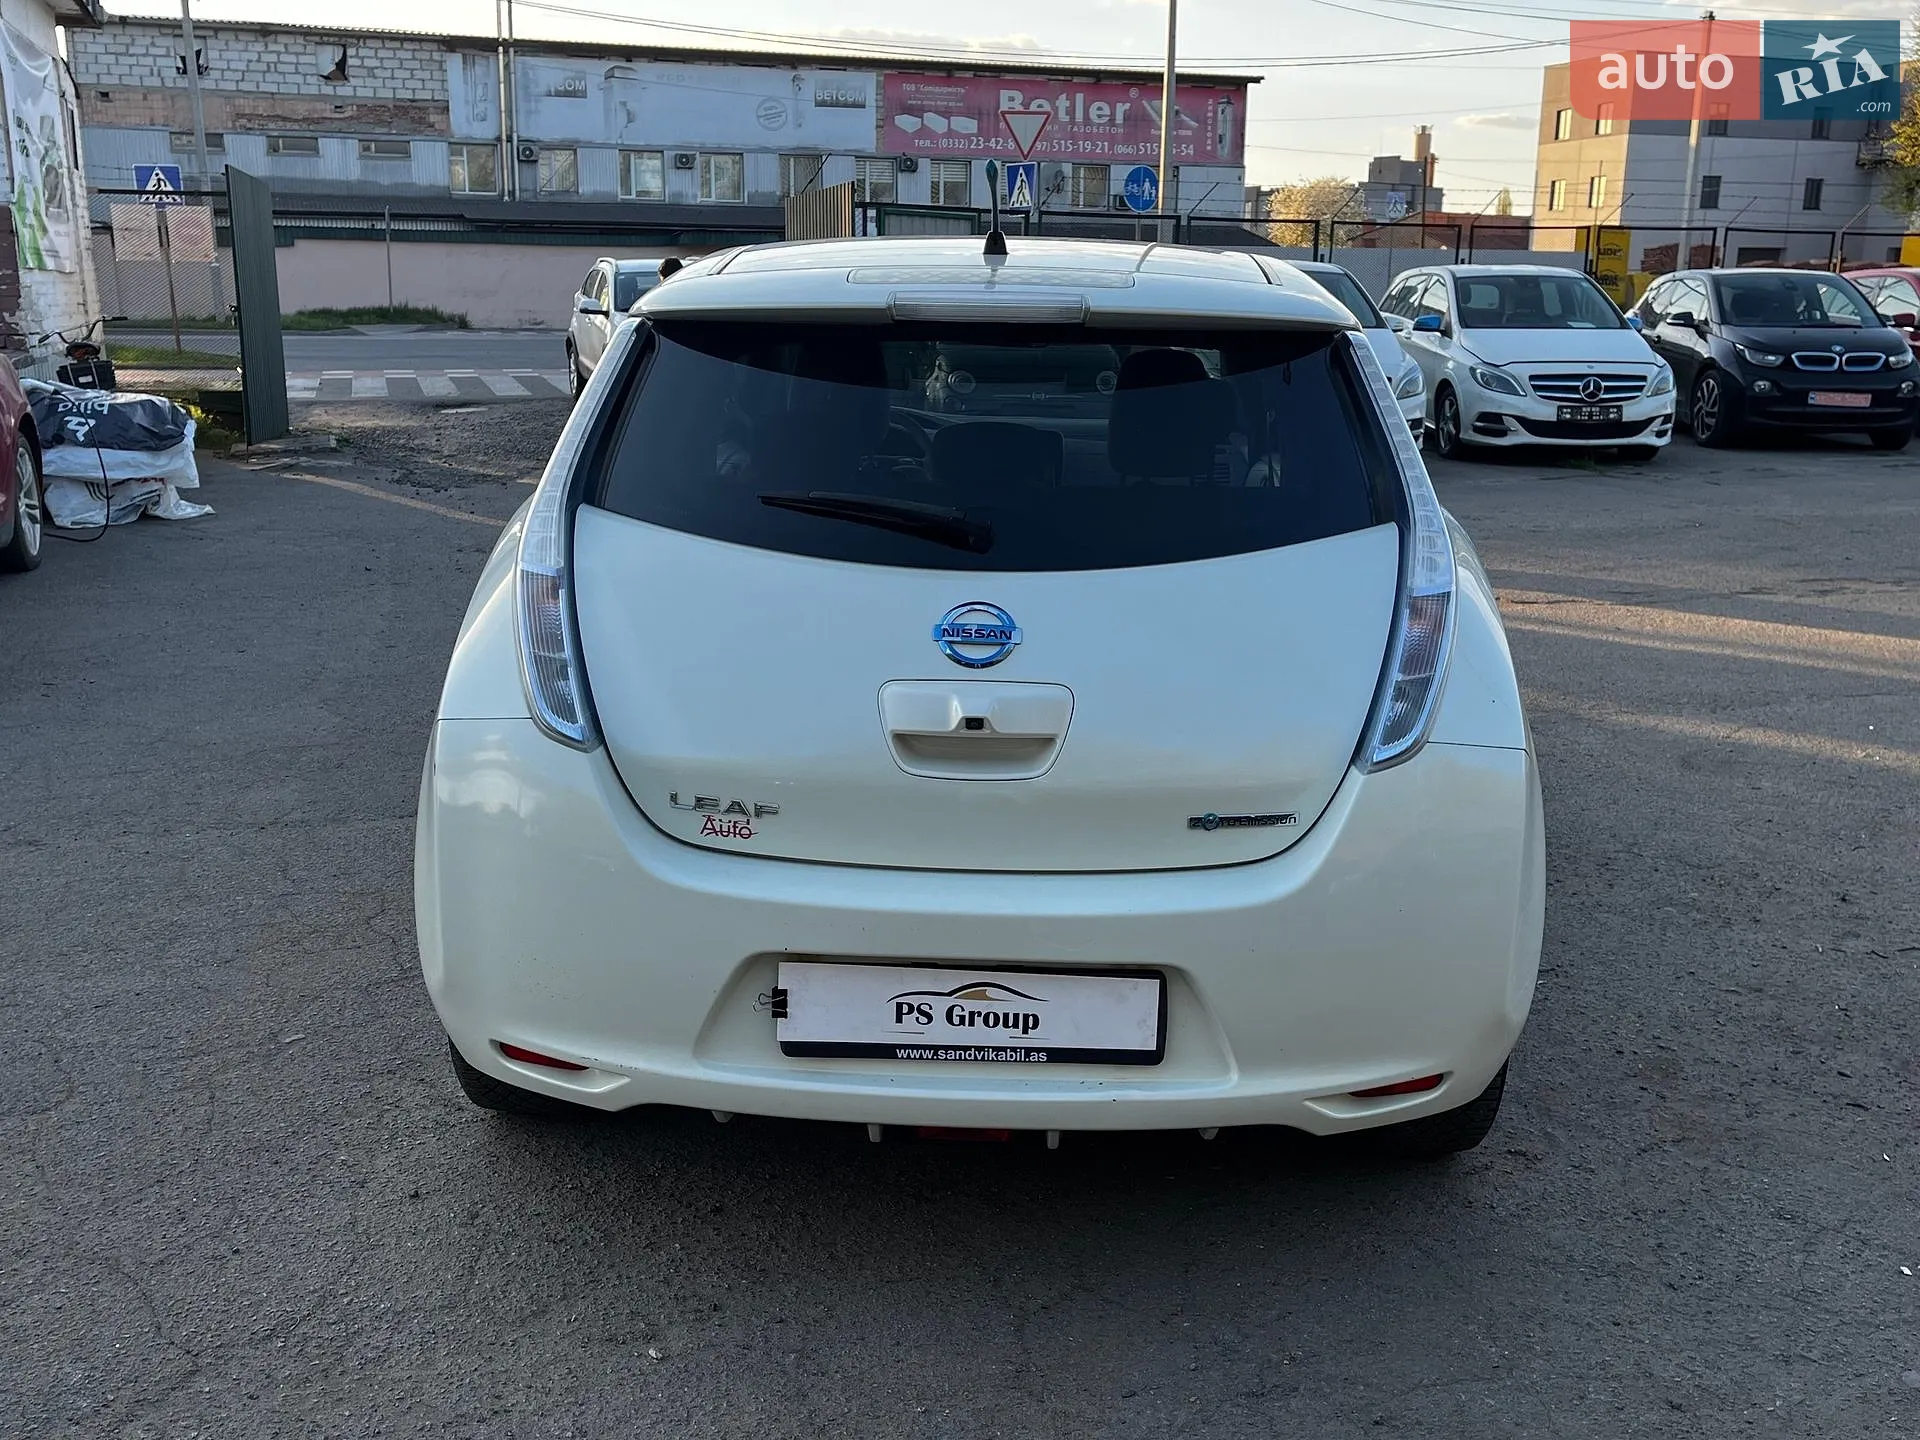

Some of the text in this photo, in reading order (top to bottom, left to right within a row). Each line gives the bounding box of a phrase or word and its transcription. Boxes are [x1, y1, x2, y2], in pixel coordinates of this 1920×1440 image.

[1067, 125, 1124, 134] ГАЗОБЕТОН
[914, 140, 936, 148] тел.:
[938, 138, 968, 150] (0332)
[970, 137, 1015, 150] 23-42-8
[1114, 144, 1137, 156] (066)
[57, 400, 111, 415] bilia
[942, 627, 1012, 641] NISSAN
[669, 791, 780, 819] LEAF
[700, 815, 753, 839] Auto
[895, 1001, 1041, 1035] PS Group
[896, 1048, 1048, 1062] www.sandvikabil.as
